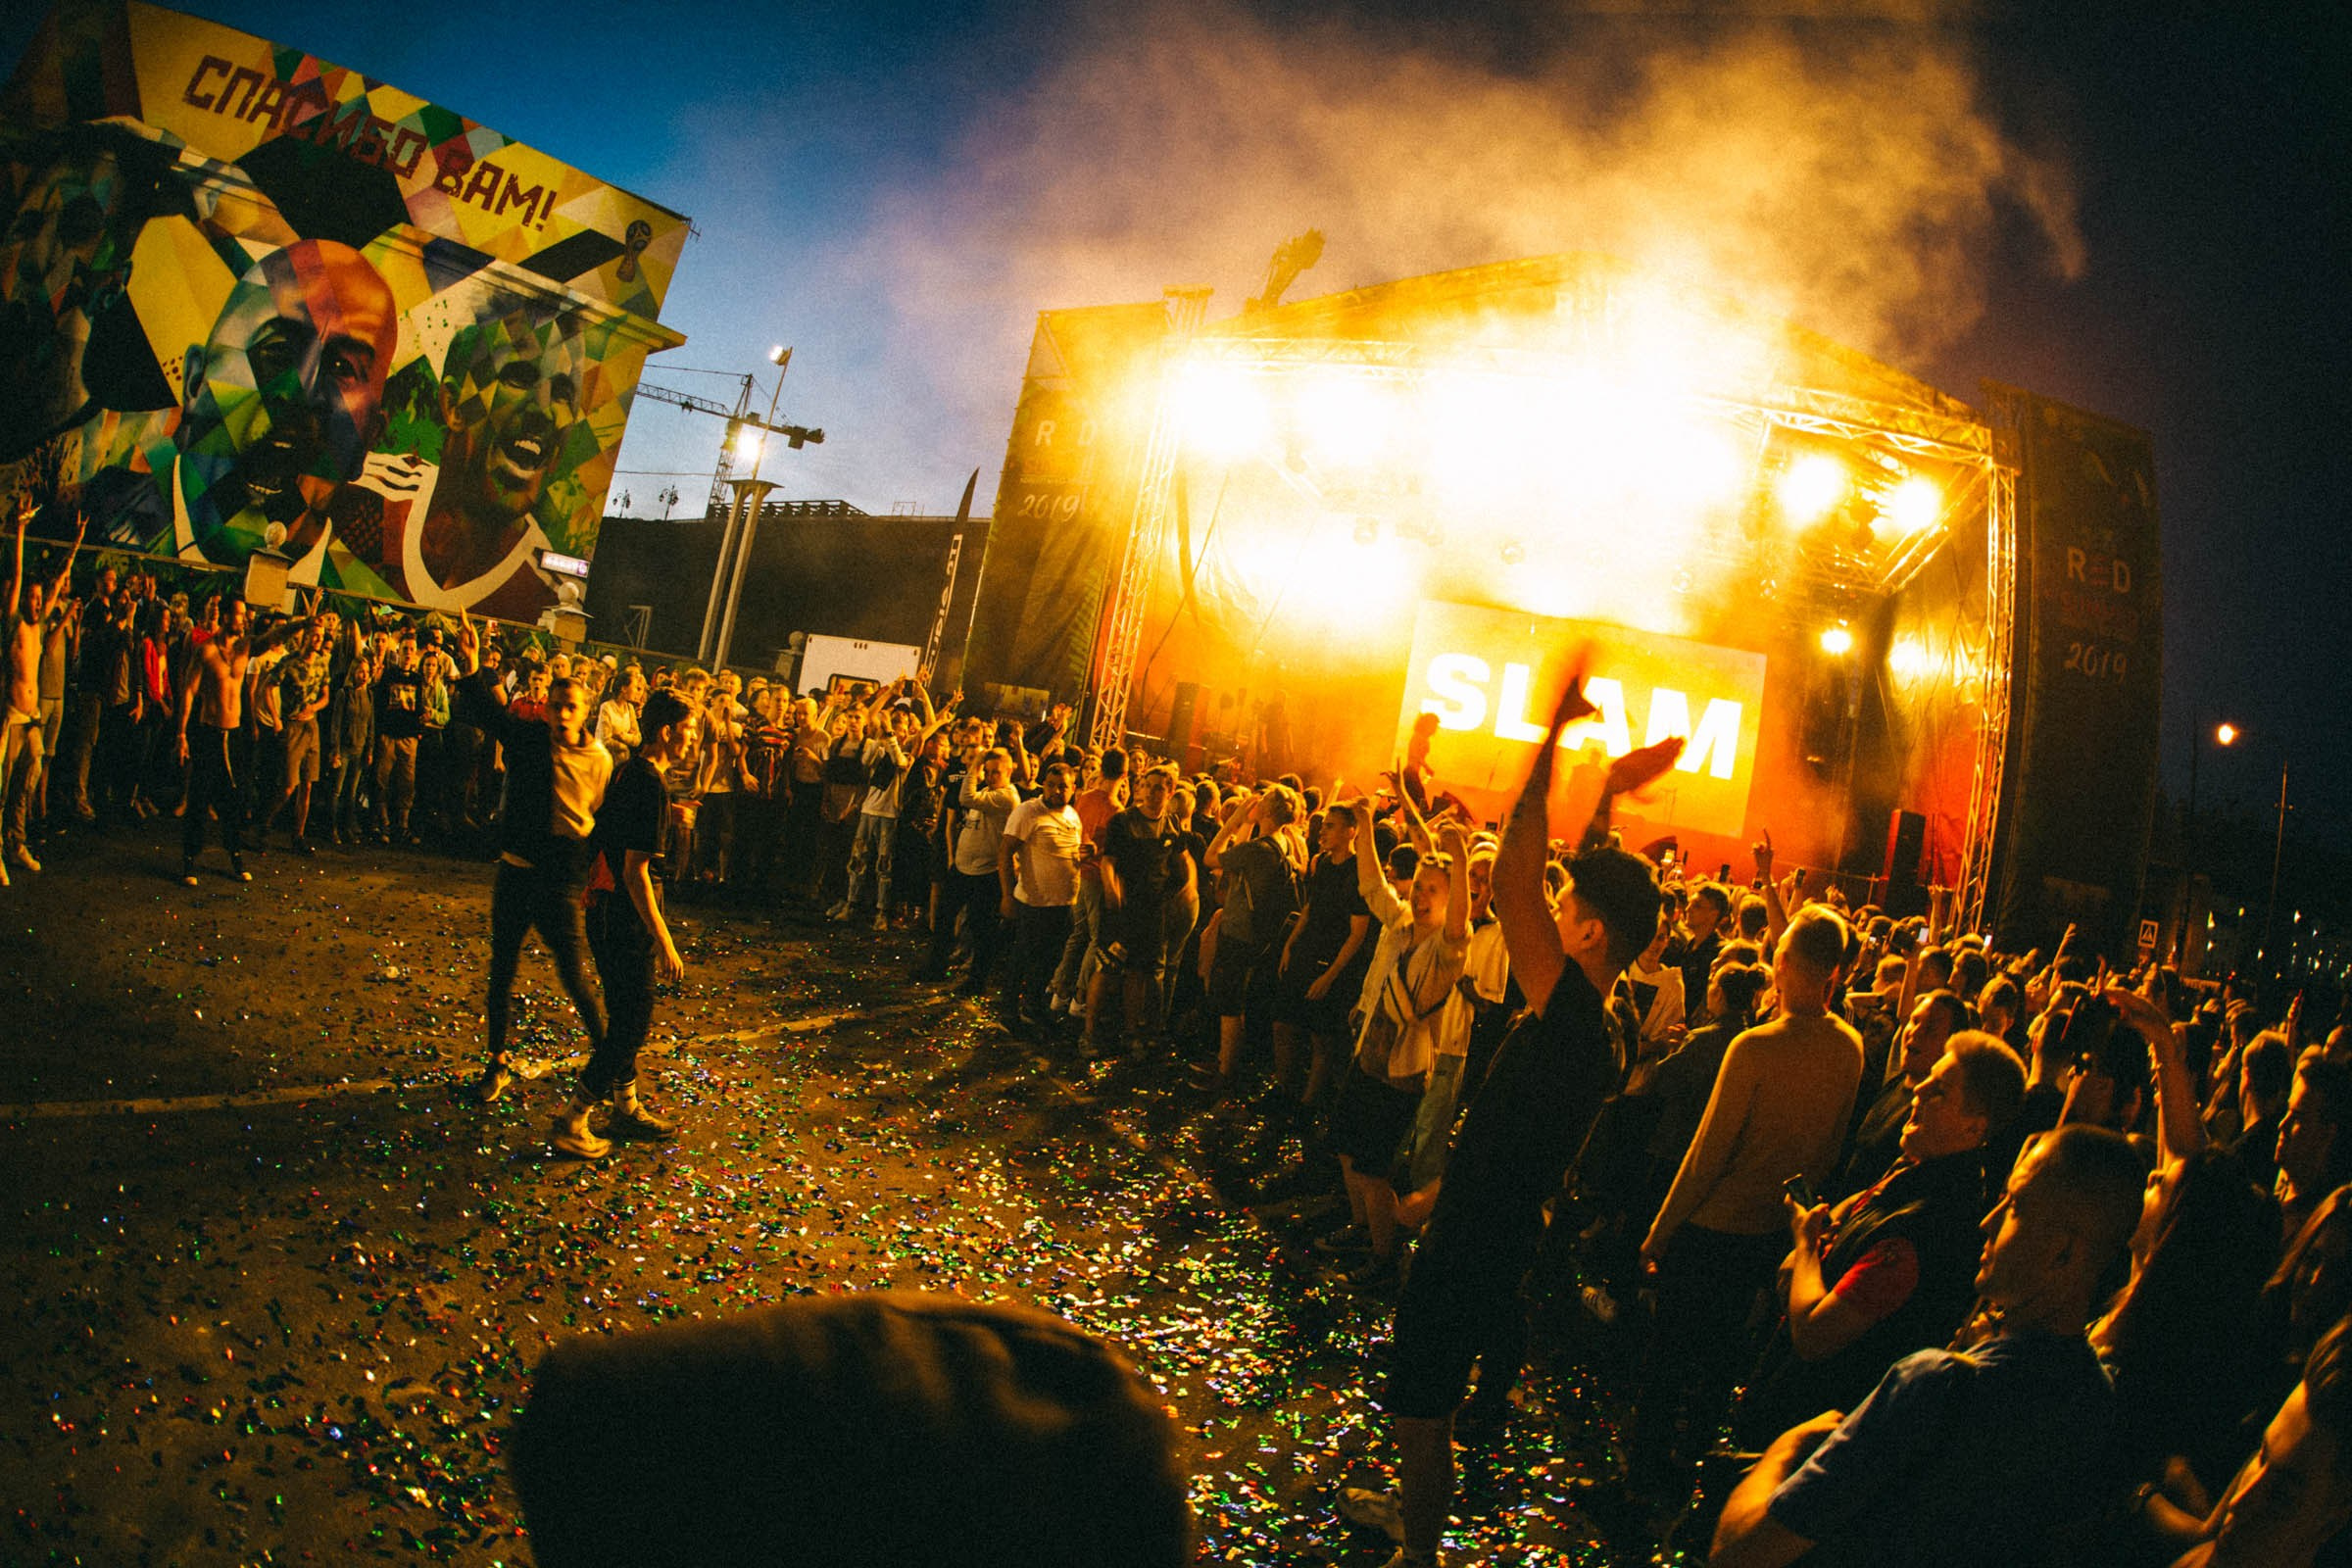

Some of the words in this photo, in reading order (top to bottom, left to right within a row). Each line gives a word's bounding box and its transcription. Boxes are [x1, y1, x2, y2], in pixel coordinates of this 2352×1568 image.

[183, 56, 429, 179] СПАСИБО
[433, 151, 558, 231] ВАМ!
[1018, 493, 1080, 521] 2019
[2063, 643, 2128, 683] 2019
[1420, 653, 1742, 780] SLAM
